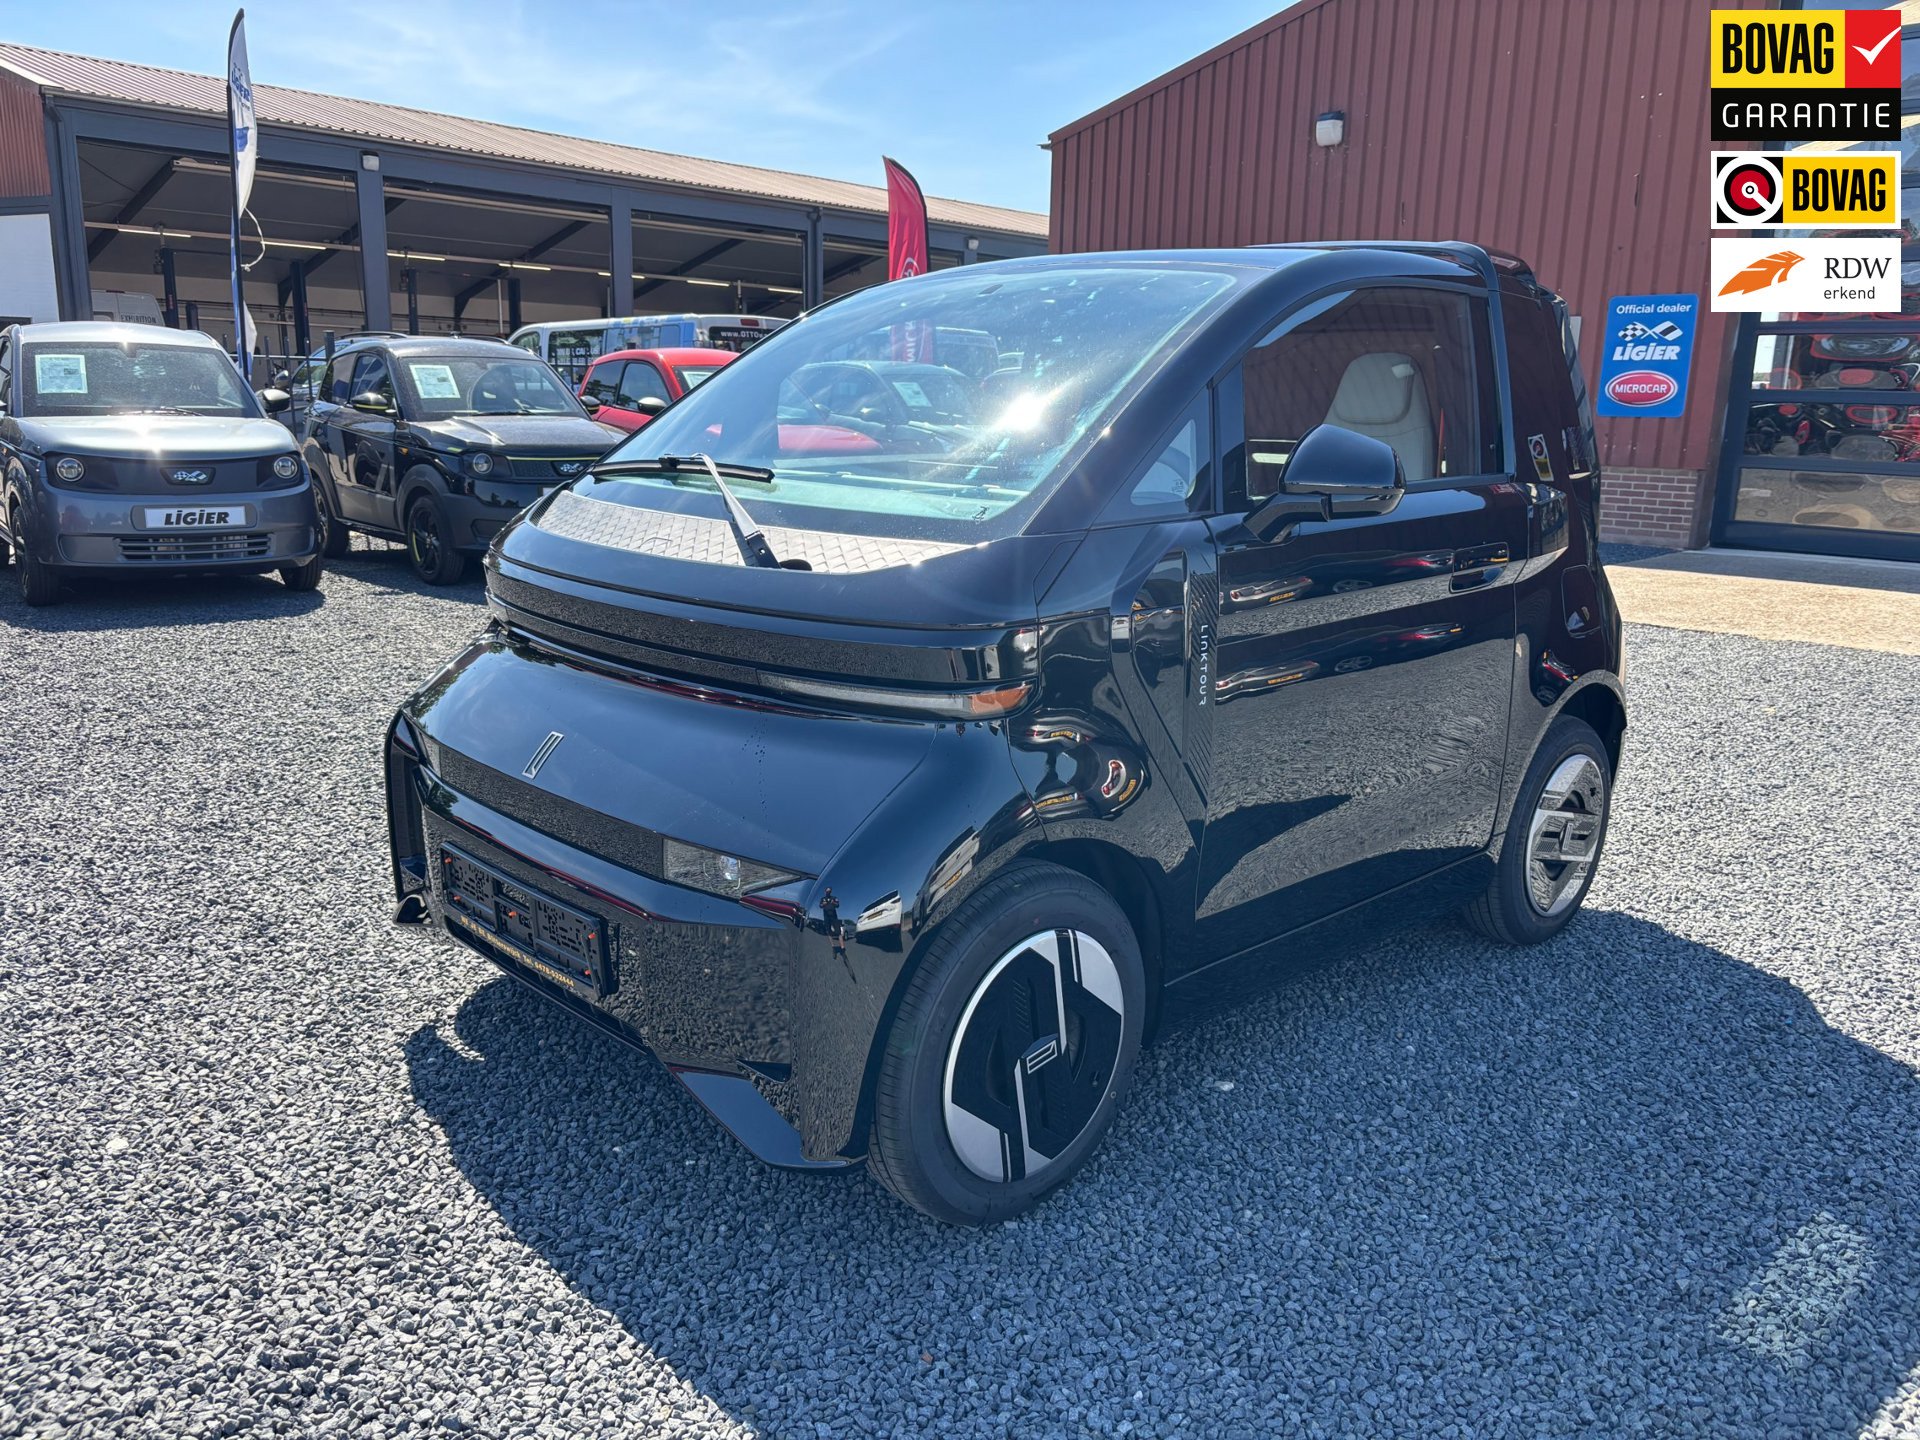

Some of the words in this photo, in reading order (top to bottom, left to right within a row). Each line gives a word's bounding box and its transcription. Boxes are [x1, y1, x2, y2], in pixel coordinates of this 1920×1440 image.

[1616, 304, 1654, 315] Official
[1656, 303, 1692, 313] dealer
[1615, 384, 1668, 394] MICROCAR
[1199, 624, 1209, 706] LINKTOUR
